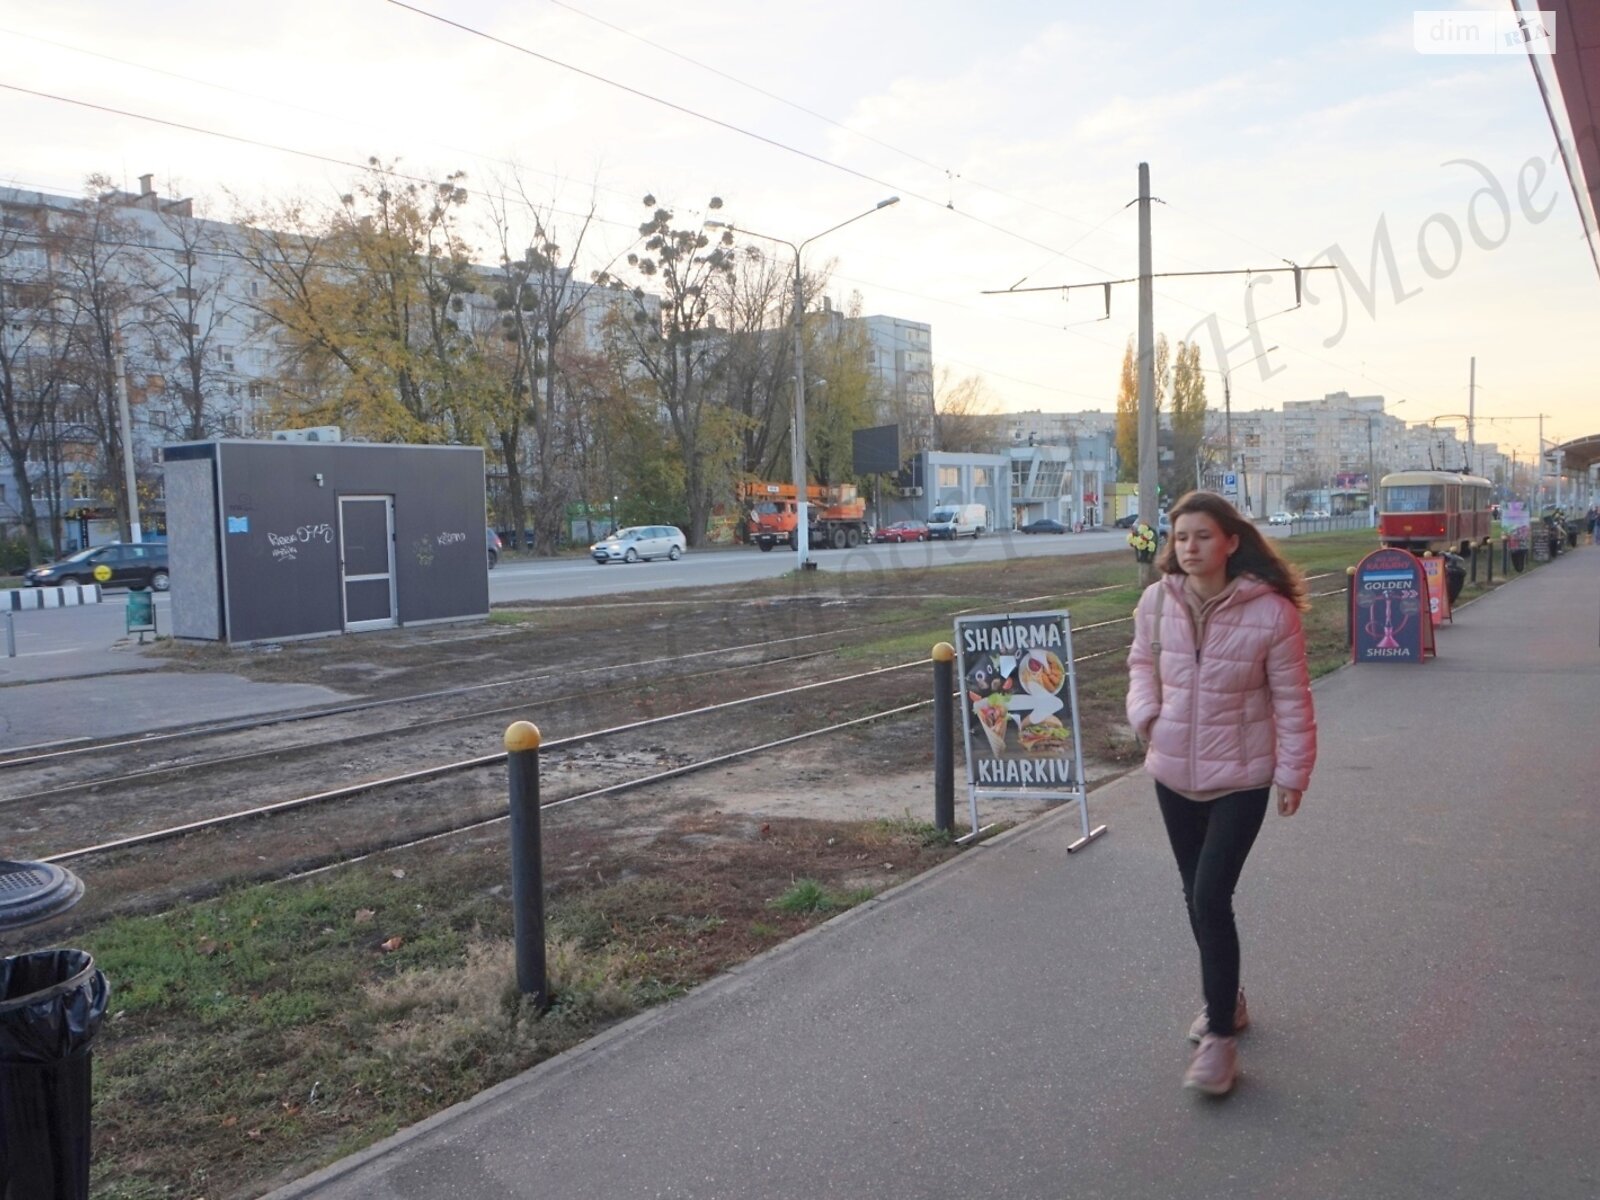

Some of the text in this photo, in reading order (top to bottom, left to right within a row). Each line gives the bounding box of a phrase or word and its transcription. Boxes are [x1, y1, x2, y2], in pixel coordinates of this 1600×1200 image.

[1364, 581, 1412, 590] GOLDEN
[964, 623, 1062, 652] SHAURMA
[1366, 647, 1411, 657] SHISHA
[978, 758, 1070, 783] KHARKIV
